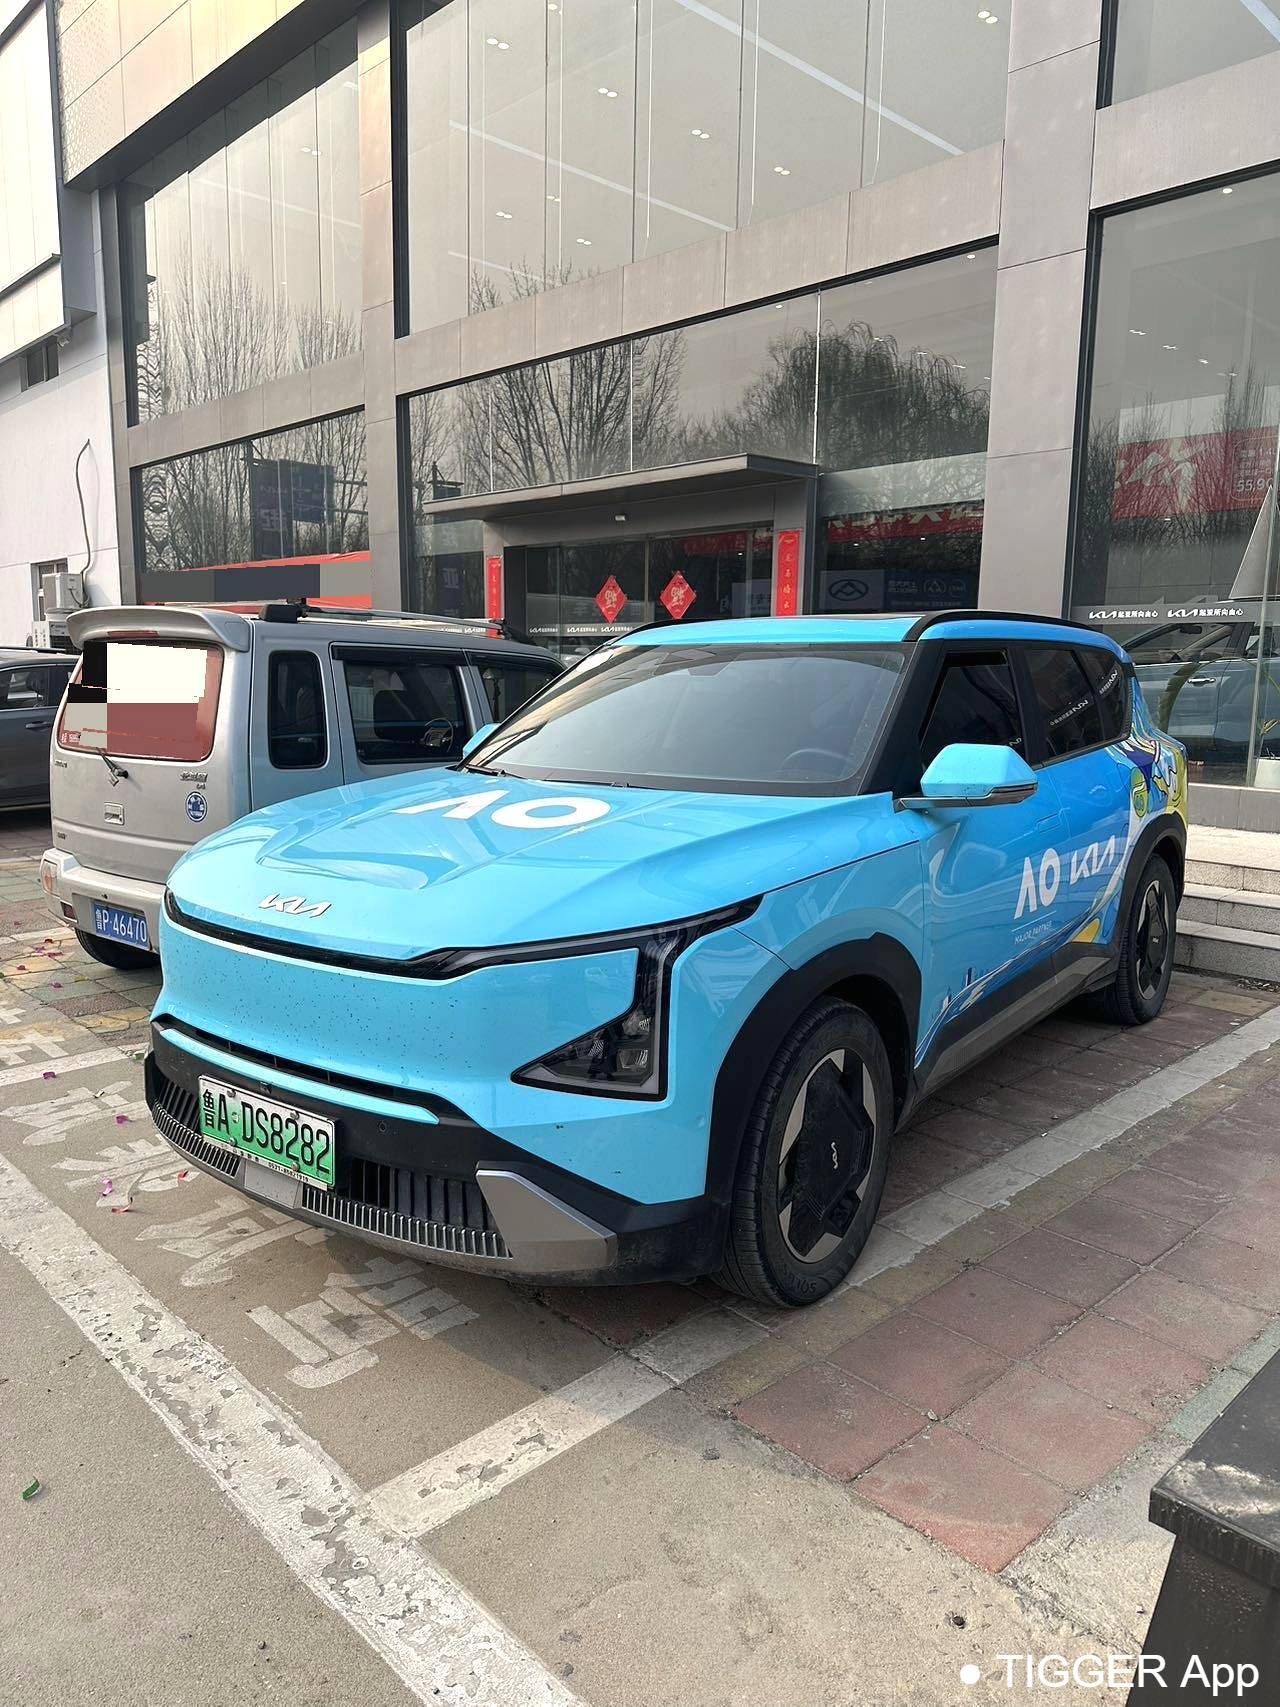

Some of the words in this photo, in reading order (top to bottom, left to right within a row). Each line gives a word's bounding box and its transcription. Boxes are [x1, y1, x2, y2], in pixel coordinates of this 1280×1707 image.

[1167, 608, 1198, 618] KIA
[1069, 834, 1115, 886] KIA
[258, 893, 332, 918] KIA
